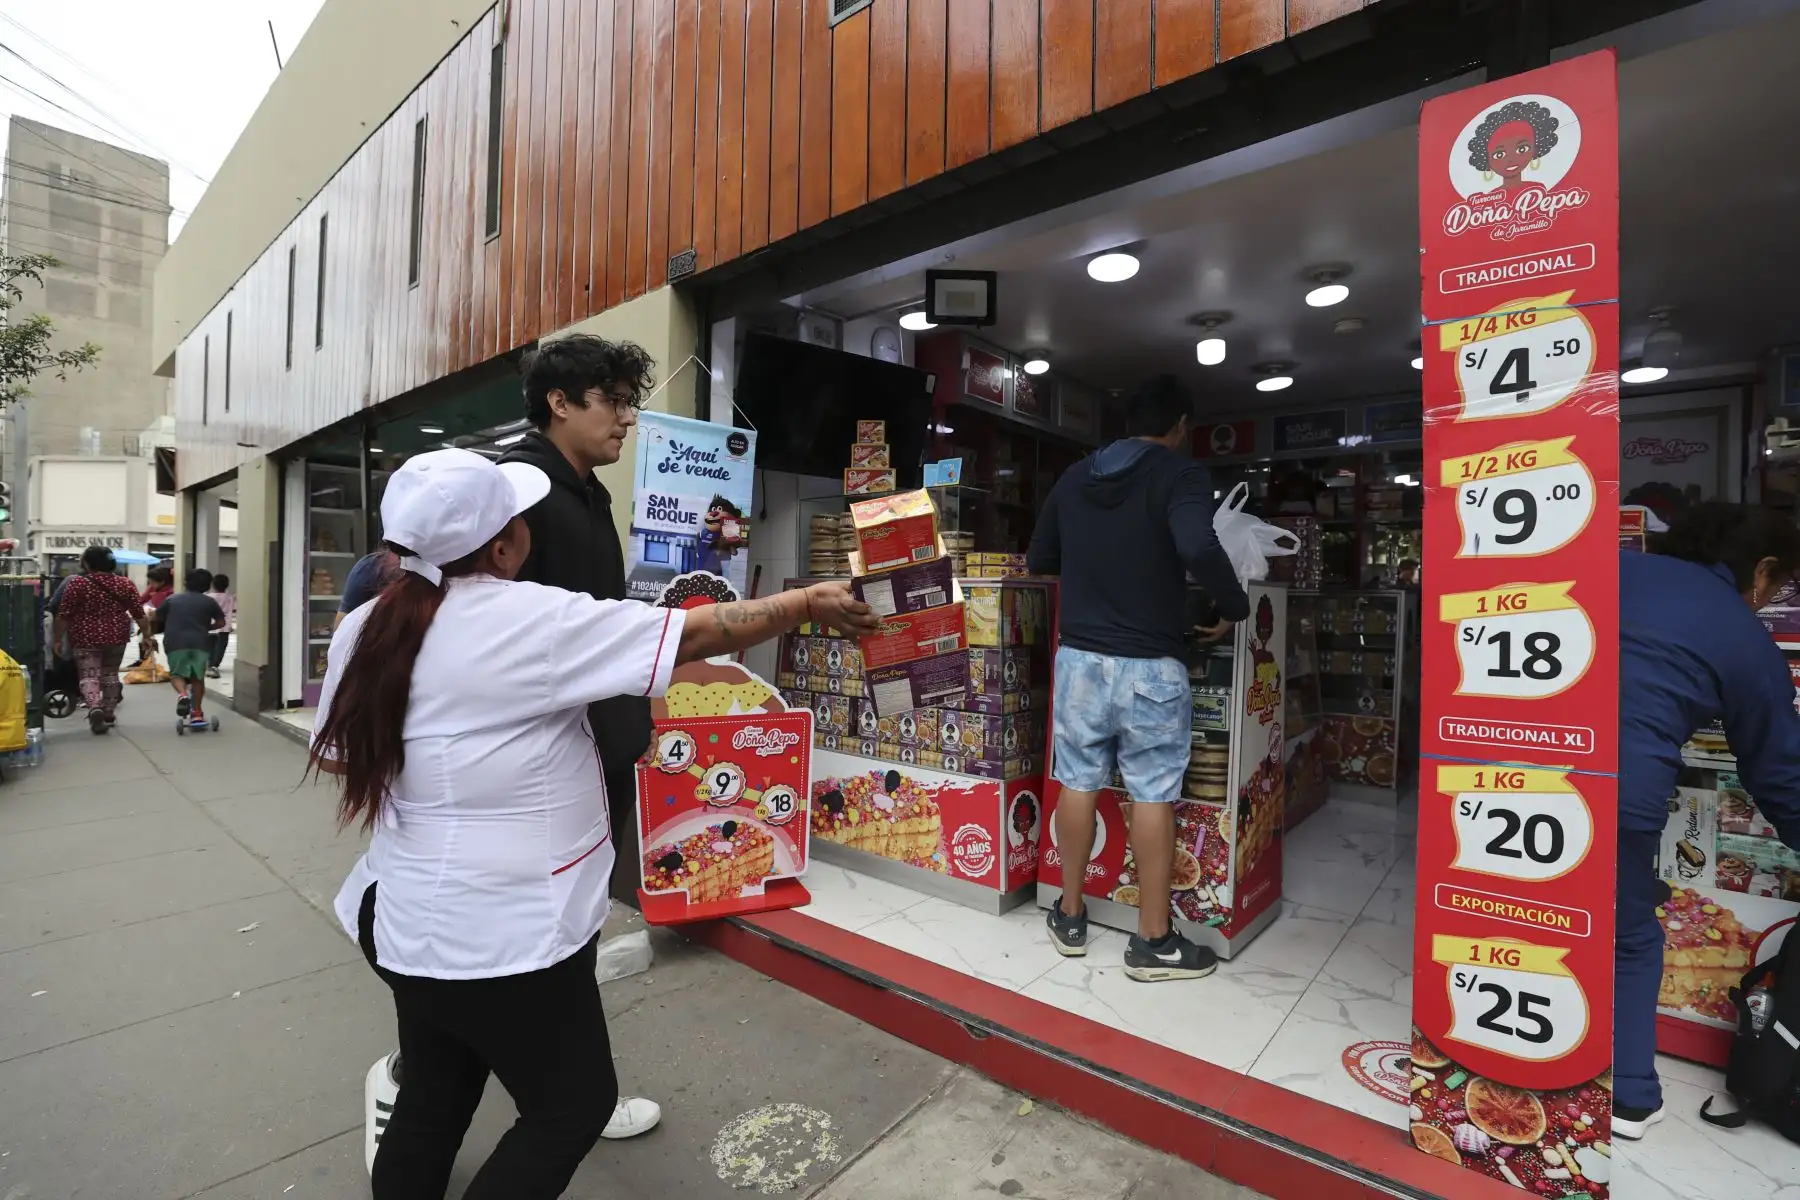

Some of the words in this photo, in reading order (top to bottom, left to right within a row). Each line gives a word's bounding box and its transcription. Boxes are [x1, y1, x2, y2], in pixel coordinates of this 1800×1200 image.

[1470, 192, 1503, 205] Turrones
[1446, 204, 1513, 234] Doña
[1515, 189, 1586, 219] Pepa
[1494, 226, 1504, 237] de
[1505, 219, 1549, 238] Jaramillo
[1456, 253, 1575, 287] TRADICIONAL
[1459, 315, 1498, 342] 1/4
[1505, 306, 1537, 330] KG
[1465, 348, 1488, 369] S/
[1489, 347, 1537, 403] 4
[1545, 338, 1581, 358] .50
[676, 446, 718, 464] Aquí
[1460, 456, 1498, 480] 1/2
[1506, 450, 1537, 470] KG
[657, 457, 681, 474] Se
[685, 463, 732, 481] vende
[647, 494, 679, 510] SAN
[1465, 487, 1489, 508] S/
[1492, 488, 1538, 545] 9
[1545, 483, 1581, 501] .00
[646, 507, 698, 525] ROQUE
[1476, 596, 1488, 613] 1
[1496, 592, 1528, 611] KG
[1463, 625, 1486, 646] S/
[1487, 630, 1562, 680] 18
[733, 731, 765, 747] Doña
[767, 729, 797, 746] Pepa
[1446, 722, 1560, 745] TRADICIONAL
[1563, 732, 1586, 747] XL
[668, 739, 684, 761] 4
[715, 772, 731, 794] 9
[1473, 771, 1485, 788] 1
[1494, 771, 1525, 789] KG
[771, 793, 791, 813] 18
[1459, 800, 1483, 821] S/
[1485, 808, 1564, 864] 20
[953, 845, 965, 857] 40
[967, 841, 992, 855] AÑOS
[1046, 849, 1062, 866] Do
[1086, 863, 1106, 877] epa
[1452, 893, 1571, 929] EXPORTACIÓN
[1468, 943, 1481, 962] 1
[1489, 946, 1521, 967] KG
[1454, 971, 1478, 994] S/
[1476, 982, 1554, 1044] 25
